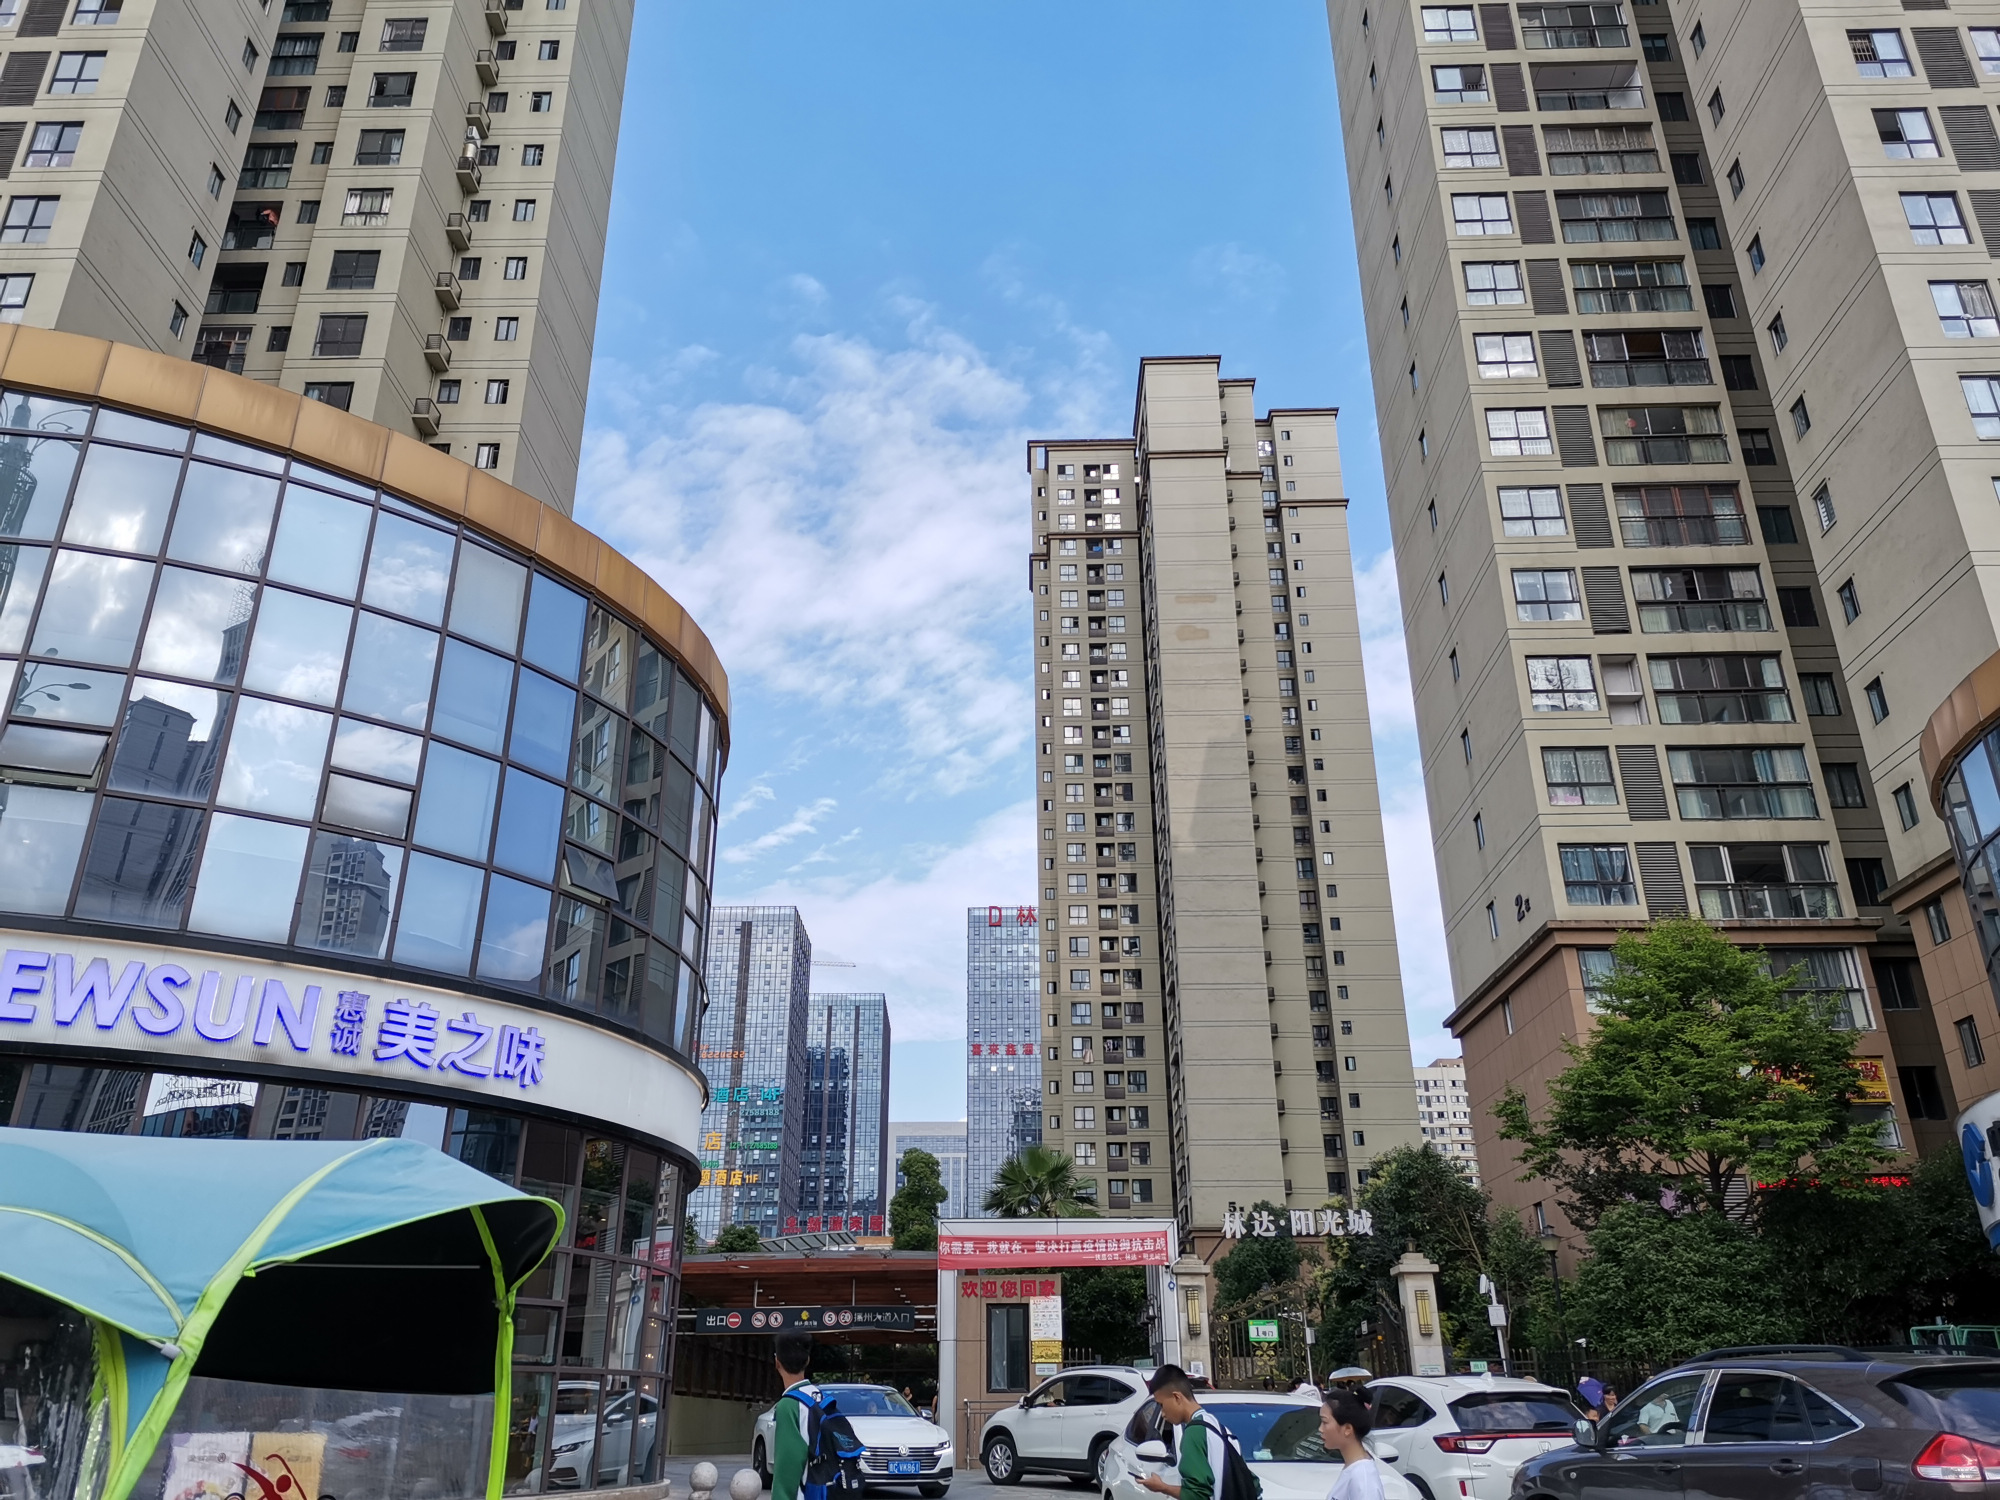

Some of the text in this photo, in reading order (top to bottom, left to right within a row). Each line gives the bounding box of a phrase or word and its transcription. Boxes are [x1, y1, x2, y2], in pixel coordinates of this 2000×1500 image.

[0, 949, 323, 1052] EWSUN
[331, 990, 370, 1056] 惠诚
[373, 998, 546, 1089] 美之味
[971, 1043, 1041, 1056] 喜来鑫酒
[713, 1087, 781, 1102] 酒店 14F
[704, 1131, 723, 1150] 店
[745, 1174, 759, 1184] 11F
[1221, 1209, 1374, 1239] 林达·阳光城
[961, 1280, 1056, 1299] 欢迎您回家
[706, 1315, 726, 1326] 出口
